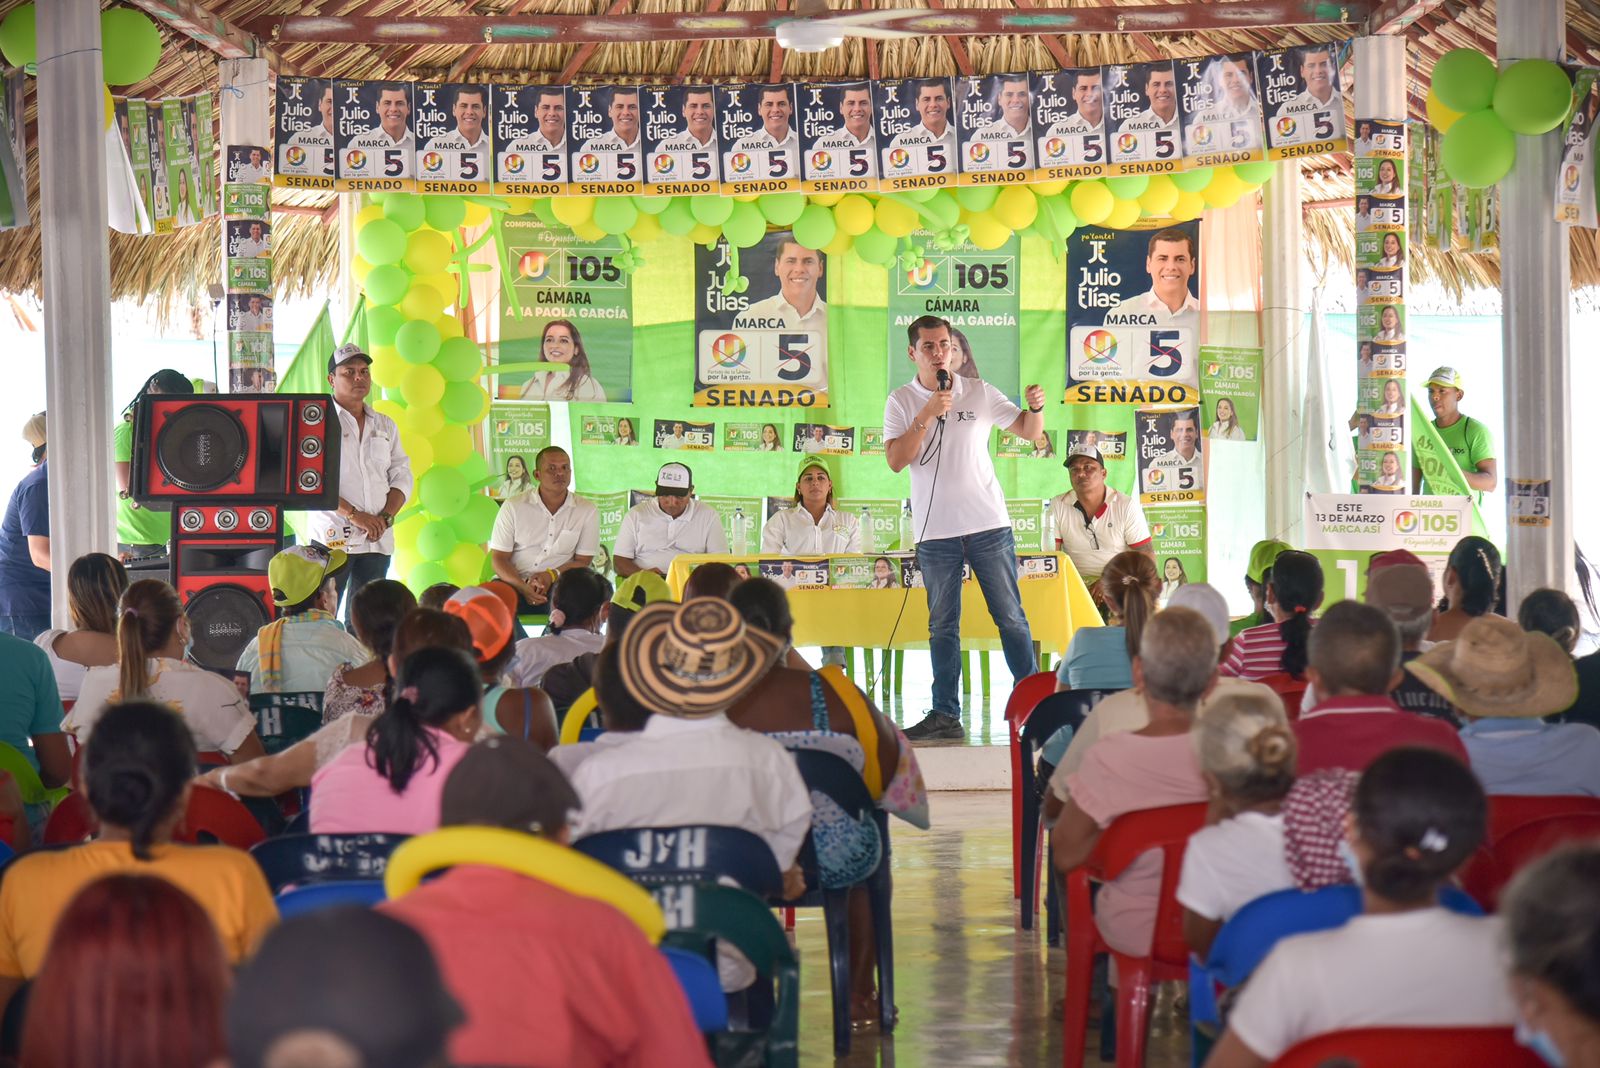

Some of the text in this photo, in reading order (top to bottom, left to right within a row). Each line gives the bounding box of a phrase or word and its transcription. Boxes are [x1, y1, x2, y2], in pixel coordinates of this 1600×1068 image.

[1266, 74, 1295, 89] Julio
[1110, 90, 1139, 104] Julio
[1182, 83, 1212, 98] Julio
[1266, 89, 1297, 105] Elías
[962, 100, 992, 114] Julio
[1037, 94, 1066, 109] Julio
[1183, 97, 1214, 113] Elías
[1286, 104, 1318, 113] MARCA
[282, 102, 312, 116] Julio
[340, 107, 370, 120] Julio
[416, 109, 446, 122] Julio
[804, 108, 834, 122] Julio
[880, 106, 910, 120] Julio
[1110, 104, 1140, 120] Elías
[499, 111, 528, 124] Julio
[572, 111, 602, 124] Julio
[647, 111, 676, 125] Julio
[723, 110, 752, 124] Julio
[962, 113, 993, 130] Elías
[1037, 109, 1068, 125] Elías
[281, 117, 311, 132] Elías
[340, 121, 371, 136] Elías
[416, 123, 446, 138] Elías
[804, 122, 835, 138] Elías
[880, 120, 911, 136] Elías
[1056, 126, 1088, 135] MARCA
[1129, 122, 1160, 130] MARCA
[1314, 112, 1333, 139] 5
[498, 124, 528, 140] Elías
[572, 124, 603, 140] Elías
[647, 125, 677, 141] Elías
[723, 124, 753, 140] Elías
[1230, 122, 1249, 148] 5
[742, 142, 773, 150] MARCA
[900, 137, 931, 145] MARCA
[1155, 131, 1174, 158] 5
[1393, 136, 1401, 149] 5
[1008, 142, 1026, 168] 5
[1083, 135, 1102, 162] 5
[1281, 143, 1334, 158] SENADO
[385, 150, 403, 176] 5
[769, 151, 788, 177] 5
[850, 150, 868, 176] 5
[927, 145, 946, 172] 5
[1197, 152, 1250, 166] SENADO
[460, 153, 478, 179] 5
[542, 155, 561, 180] 5
[617, 154, 636, 179] 5
[692, 153, 711, 179] 5
[1049, 166, 1102, 178] SENADO
[1121, 162, 1173, 174] SENADO
[286, 176, 334, 188] SENAD
[893, 176, 946, 189] SENADO
[972, 172, 1025, 183] SENADO
[349, 180, 402, 190] SENADO
[425, 183, 477, 192] SENADO
[506, 184, 559, 194] SENADO
[582, 184, 634, 193] SENADO
[657, 184, 710, 194] SENADO
[734, 181, 787, 193] SENADO
[815, 180, 867, 191] SENADO
[245, 194, 262, 205] 105
[1392, 210, 1400, 222] 5
[248, 268, 267, 278] 105
[567, 256, 620, 282] 105
[955, 264, 1008, 289] 105
[1079, 267, 1121, 287] Julio
[1390, 282, 1398, 294] 5
[537, 288, 591, 304] CÁMARA
[1078, 286, 1120, 309] Elías
[925, 296, 979, 312] CÁMARA
[535, 307, 577, 318] PAOLA
[579, 306, 628, 319] GARCÍA
[968, 313, 1016, 326] GARCÍA
[1106, 314, 1157, 325] MARCA
[735, 318, 785, 328] MARCA
[777, 334, 811, 380] 5
[1149, 330, 1182, 377] 5
[1395, 356, 1402, 368] 5
[1228, 366, 1254, 379] 105
[707, 390, 815, 407] SENADO
[1078, 386, 1186, 402] SENADO
[518, 423, 543, 435] 105
[701, 434, 709, 444] 5
[842, 438, 849, 448] 5
[1142, 434, 1166, 446] Julio
[1142, 446, 1167, 459] Elías
[1179, 468, 1194, 489] 5
[1151, 492, 1194, 502] SENADO
[1533, 500, 1545, 515] 5
[602, 511, 621, 524] 105
[1346, 515, 1385, 523] MARZO
[1422, 515, 1457, 532] 105
[343, 527, 350, 538] 5
[1173, 524, 1199, 537] 105
[1363, 524, 1380, 533] ASÍ
[851, 566, 869, 576] 105
[1044, 560, 1053, 571] 5
[815, 571, 824, 583] 5
